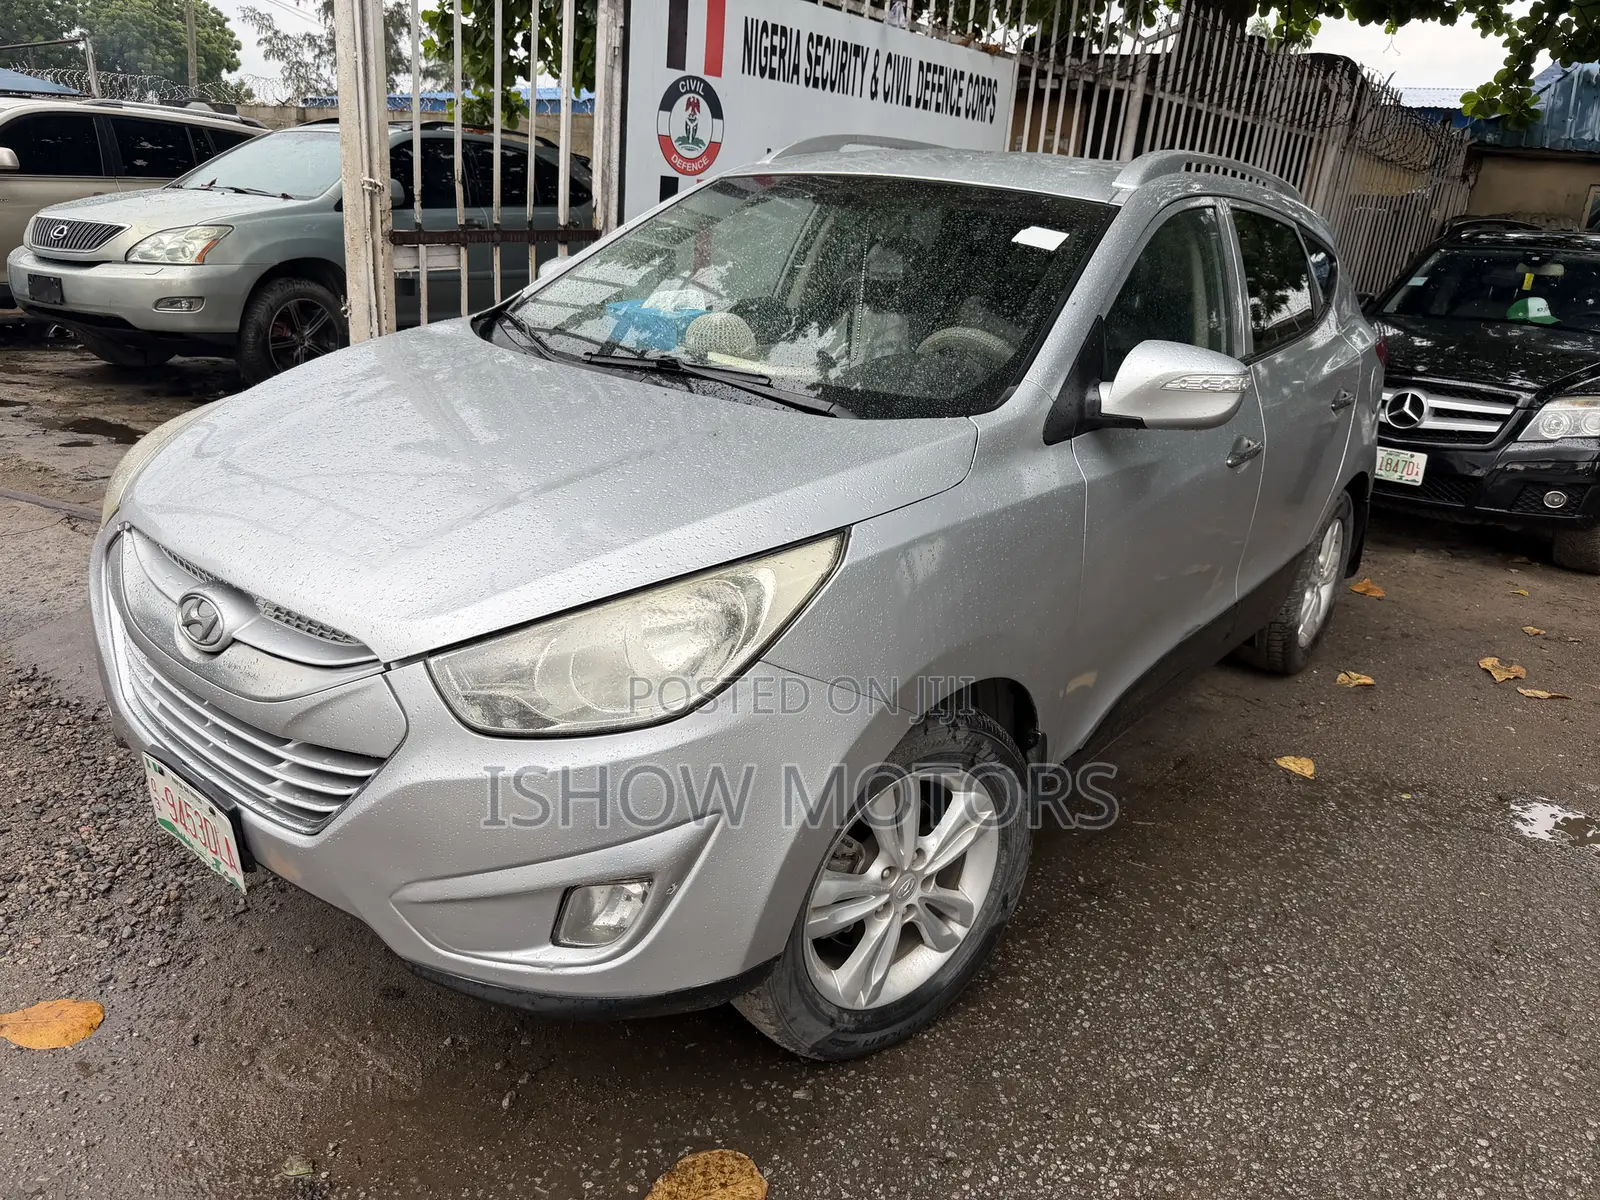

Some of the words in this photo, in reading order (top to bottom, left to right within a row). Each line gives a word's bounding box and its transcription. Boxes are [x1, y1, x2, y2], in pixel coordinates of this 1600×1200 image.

[742, 16, 801, 86] NIGERIA
[804, 31, 870, 98] SECURITY
[870, 48, 880, 101] &
[883, 51, 912, 107] CIVIL
[915, 60, 965, 118] DEFENCE
[965, 72, 998, 125] CORPS
[679, 79, 705, 96] CIVIL
[671, 154, 709, 172] DEFENCE
